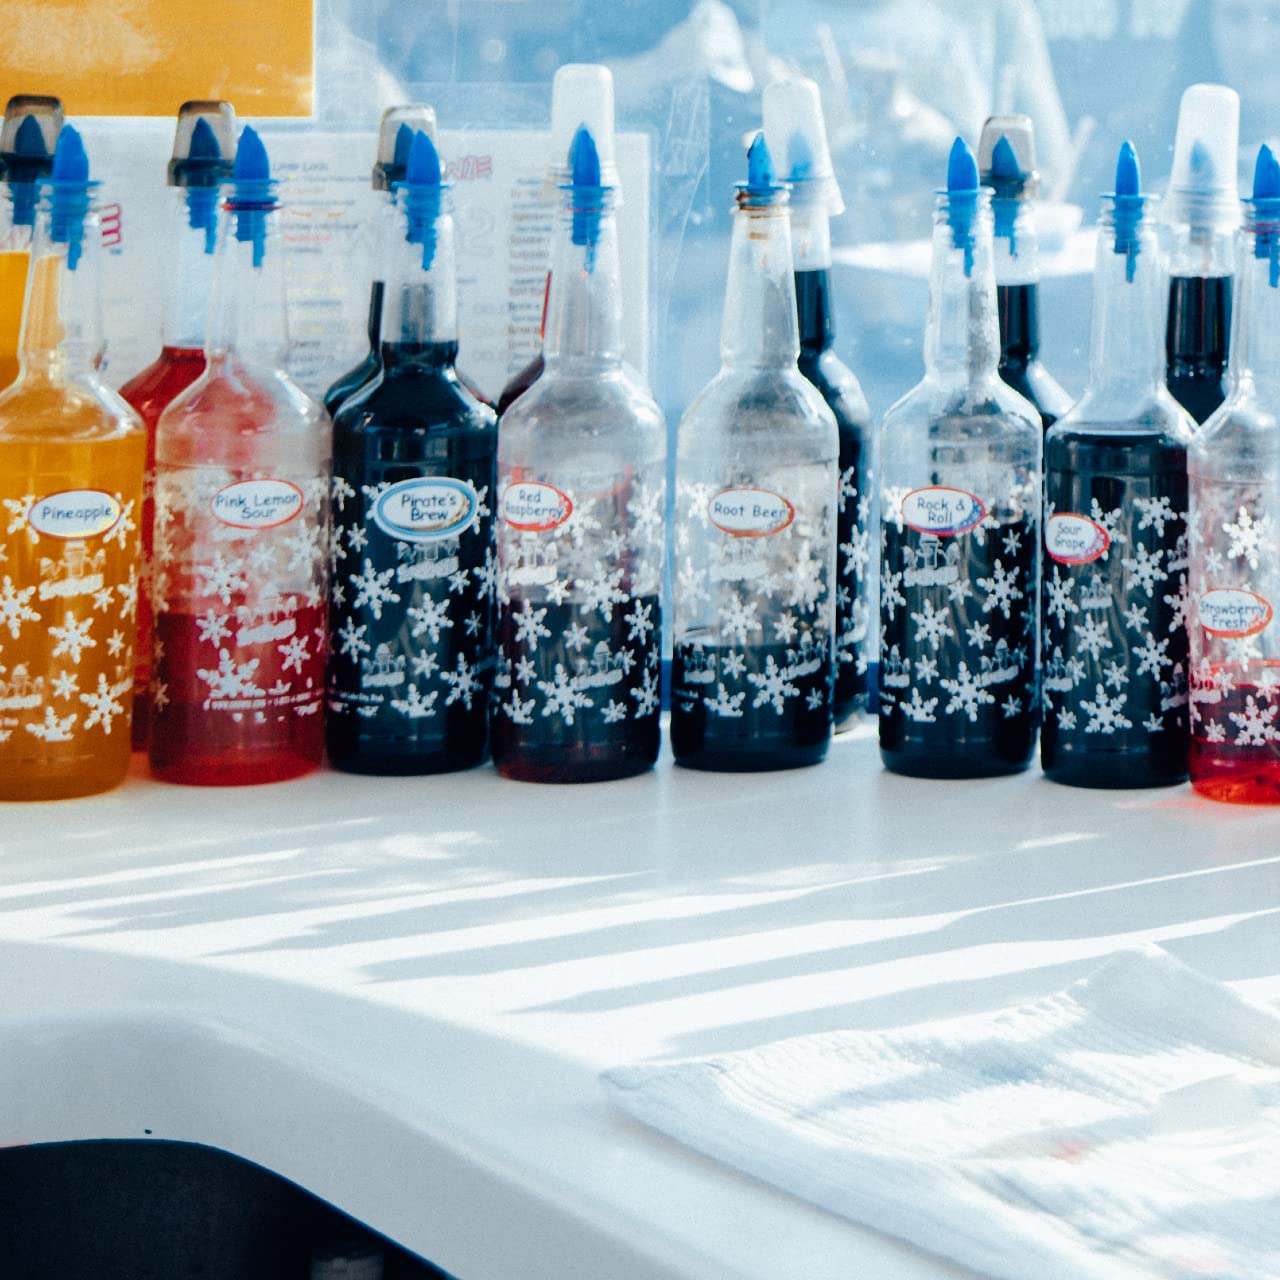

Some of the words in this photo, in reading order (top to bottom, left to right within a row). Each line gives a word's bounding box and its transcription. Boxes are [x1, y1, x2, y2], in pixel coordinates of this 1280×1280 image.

[215, 495, 246, 507] Pink
[255, 493, 298, 505] Lemon
[401, 493, 456, 507] Pirate's
[519, 490, 541, 503] Red
[505, 503, 563, 520] Raspberry
[714, 502, 744, 516] Root
[752, 504, 785, 518] Beer
[917, 498, 949, 512] Rock
[956, 499, 964, 511] &
[42, 505, 111, 521] Pineapple
[241, 507, 275, 520] Sour
[410, 508, 449, 521] Brew
[928, 511, 952, 523] Roll
[1058, 522, 1082, 535] Sour
[1054, 535, 1085, 549] Grape
[1200, 599, 1266, 617] Strawberry
[1212, 615, 1248, 628] Fresh
